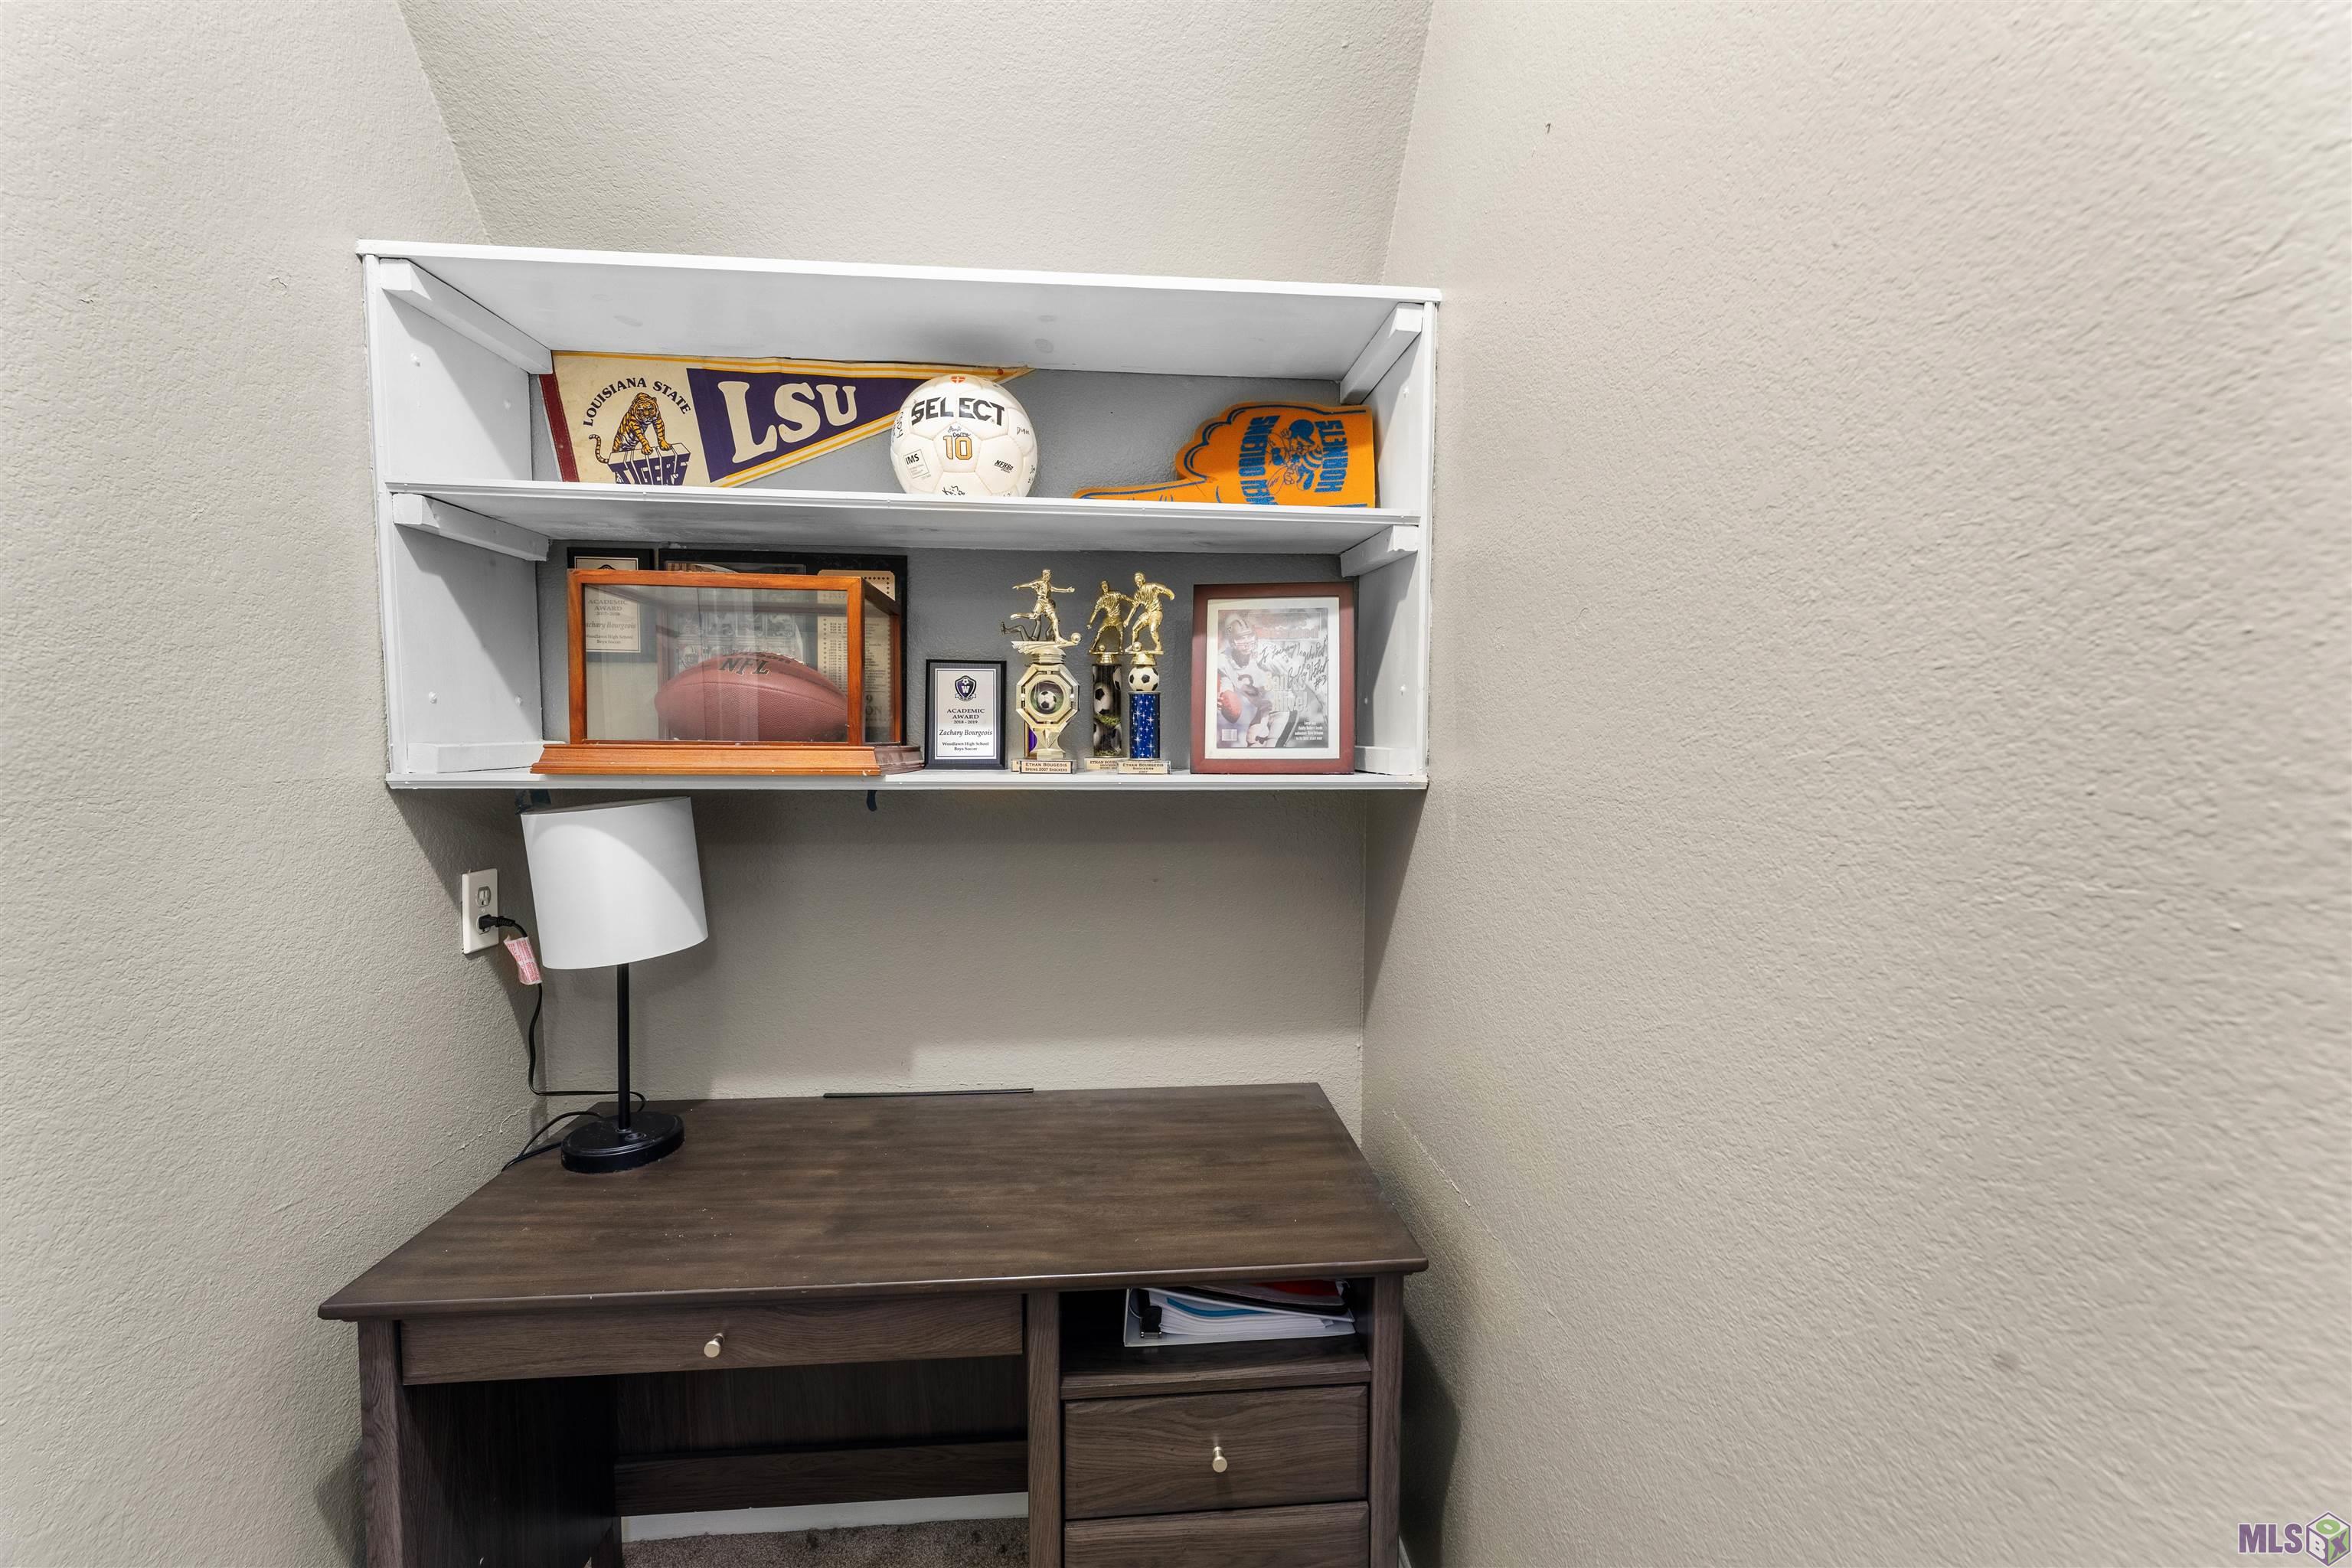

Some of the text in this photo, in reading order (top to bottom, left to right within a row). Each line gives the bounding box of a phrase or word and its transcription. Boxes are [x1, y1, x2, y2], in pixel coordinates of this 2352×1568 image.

[583, 377, 691, 426] LOUISIANA STATE
[911, 397, 1004, 426] SELECT
[718, 381, 858, 463] LSU
[905, 453, 920, 465] IMS
[943, 435, 973, 460] 10
[1239, 416, 1280, 476] ORLEANS
[1314, 420, 1348, 492] HORNETS
[719, 658, 770, 675] NFL
[939, 729, 993, 737] Zachary Bourgeois
